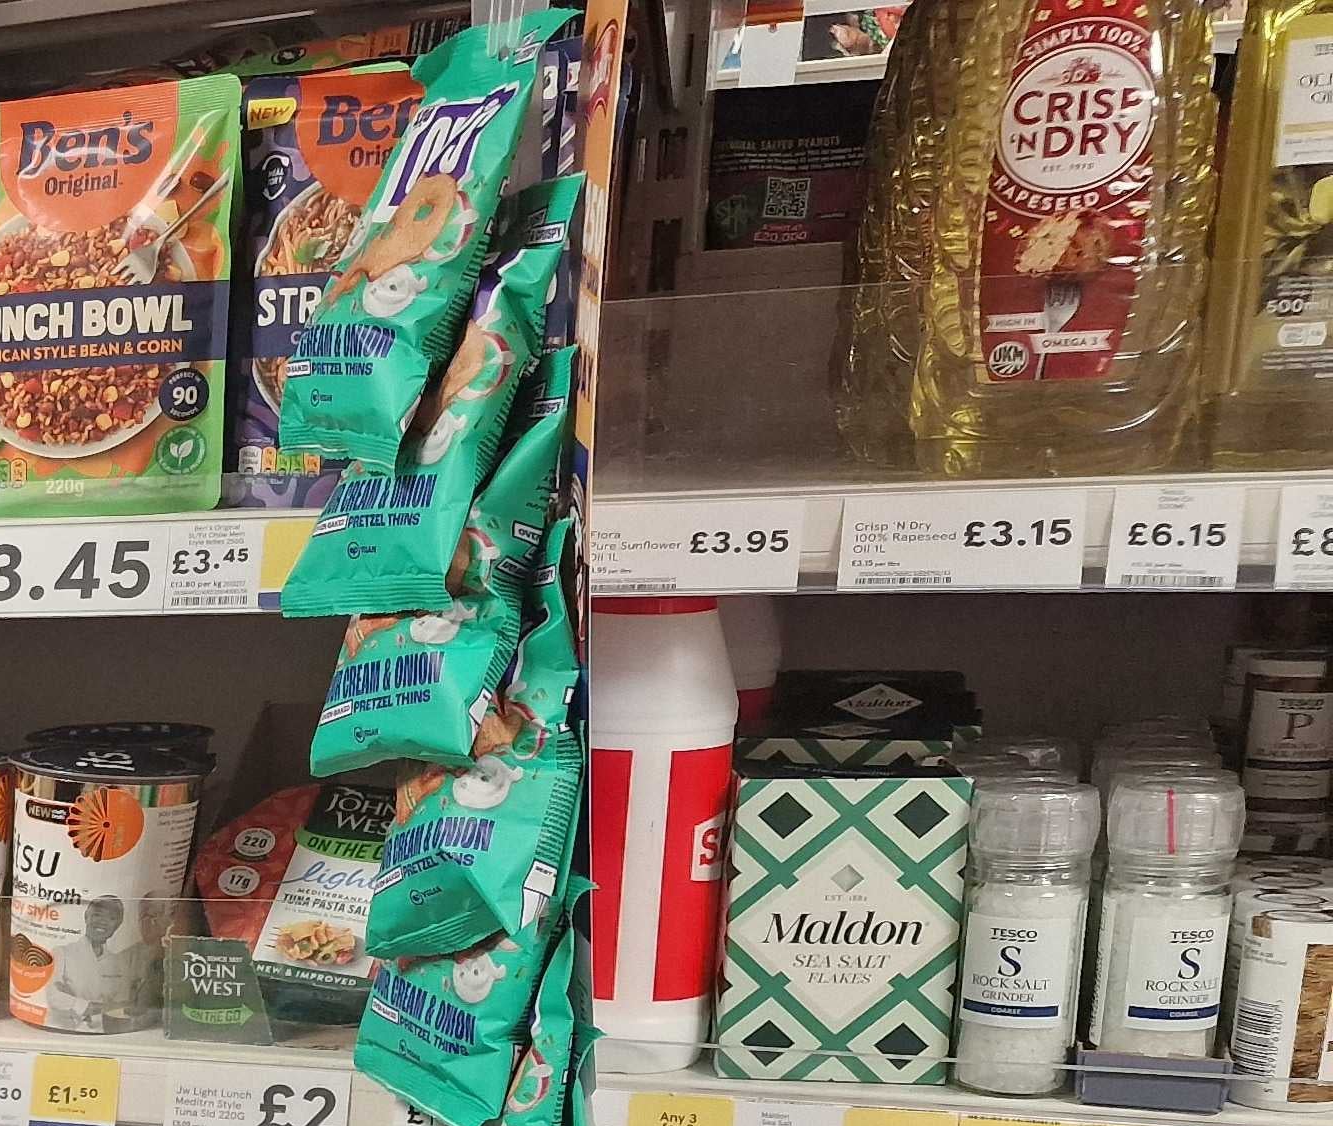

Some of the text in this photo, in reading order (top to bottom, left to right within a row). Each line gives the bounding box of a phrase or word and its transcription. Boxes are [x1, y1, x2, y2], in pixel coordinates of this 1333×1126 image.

[16, 110, 154, 175] Ben's
[44, 168, 120, 195] Original
[89, 294, 192, 338] BOWL
[33, 344, 76, 361] STYLE
[79, 342, 120, 358] BEAN
[123, 340, 133, 356] &
[137, 337, 182, 354] CORN
[854, 531, 956, 543] 100% Rapeseed
[855, 521, 889, 532] Crisp
[910, 521, 932, 532] Dry
[964, 518, 1072, 548] £3.15
[1127, 522, 1226, 547] £6.15
[689, 529, 789, 553] £3.95
[172, 548, 249, 575] £3.45
[763, 911, 924, 946] Maldon
[183, 961, 236, 982] JOHN
[792, 953, 891, 970] SEA SALT
[194, 978, 245, 996] WEST
[806, 971, 872, 985] FLAKES
[973, 974, 1050, 990] ROCK SALT
[982, 990, 1034, 1002] GRINDER
[49, 1085, 98, 1104] £1.50
[192, 1087, 216, 1099] Light
[220, 1087, 252, 1099] Lunch
